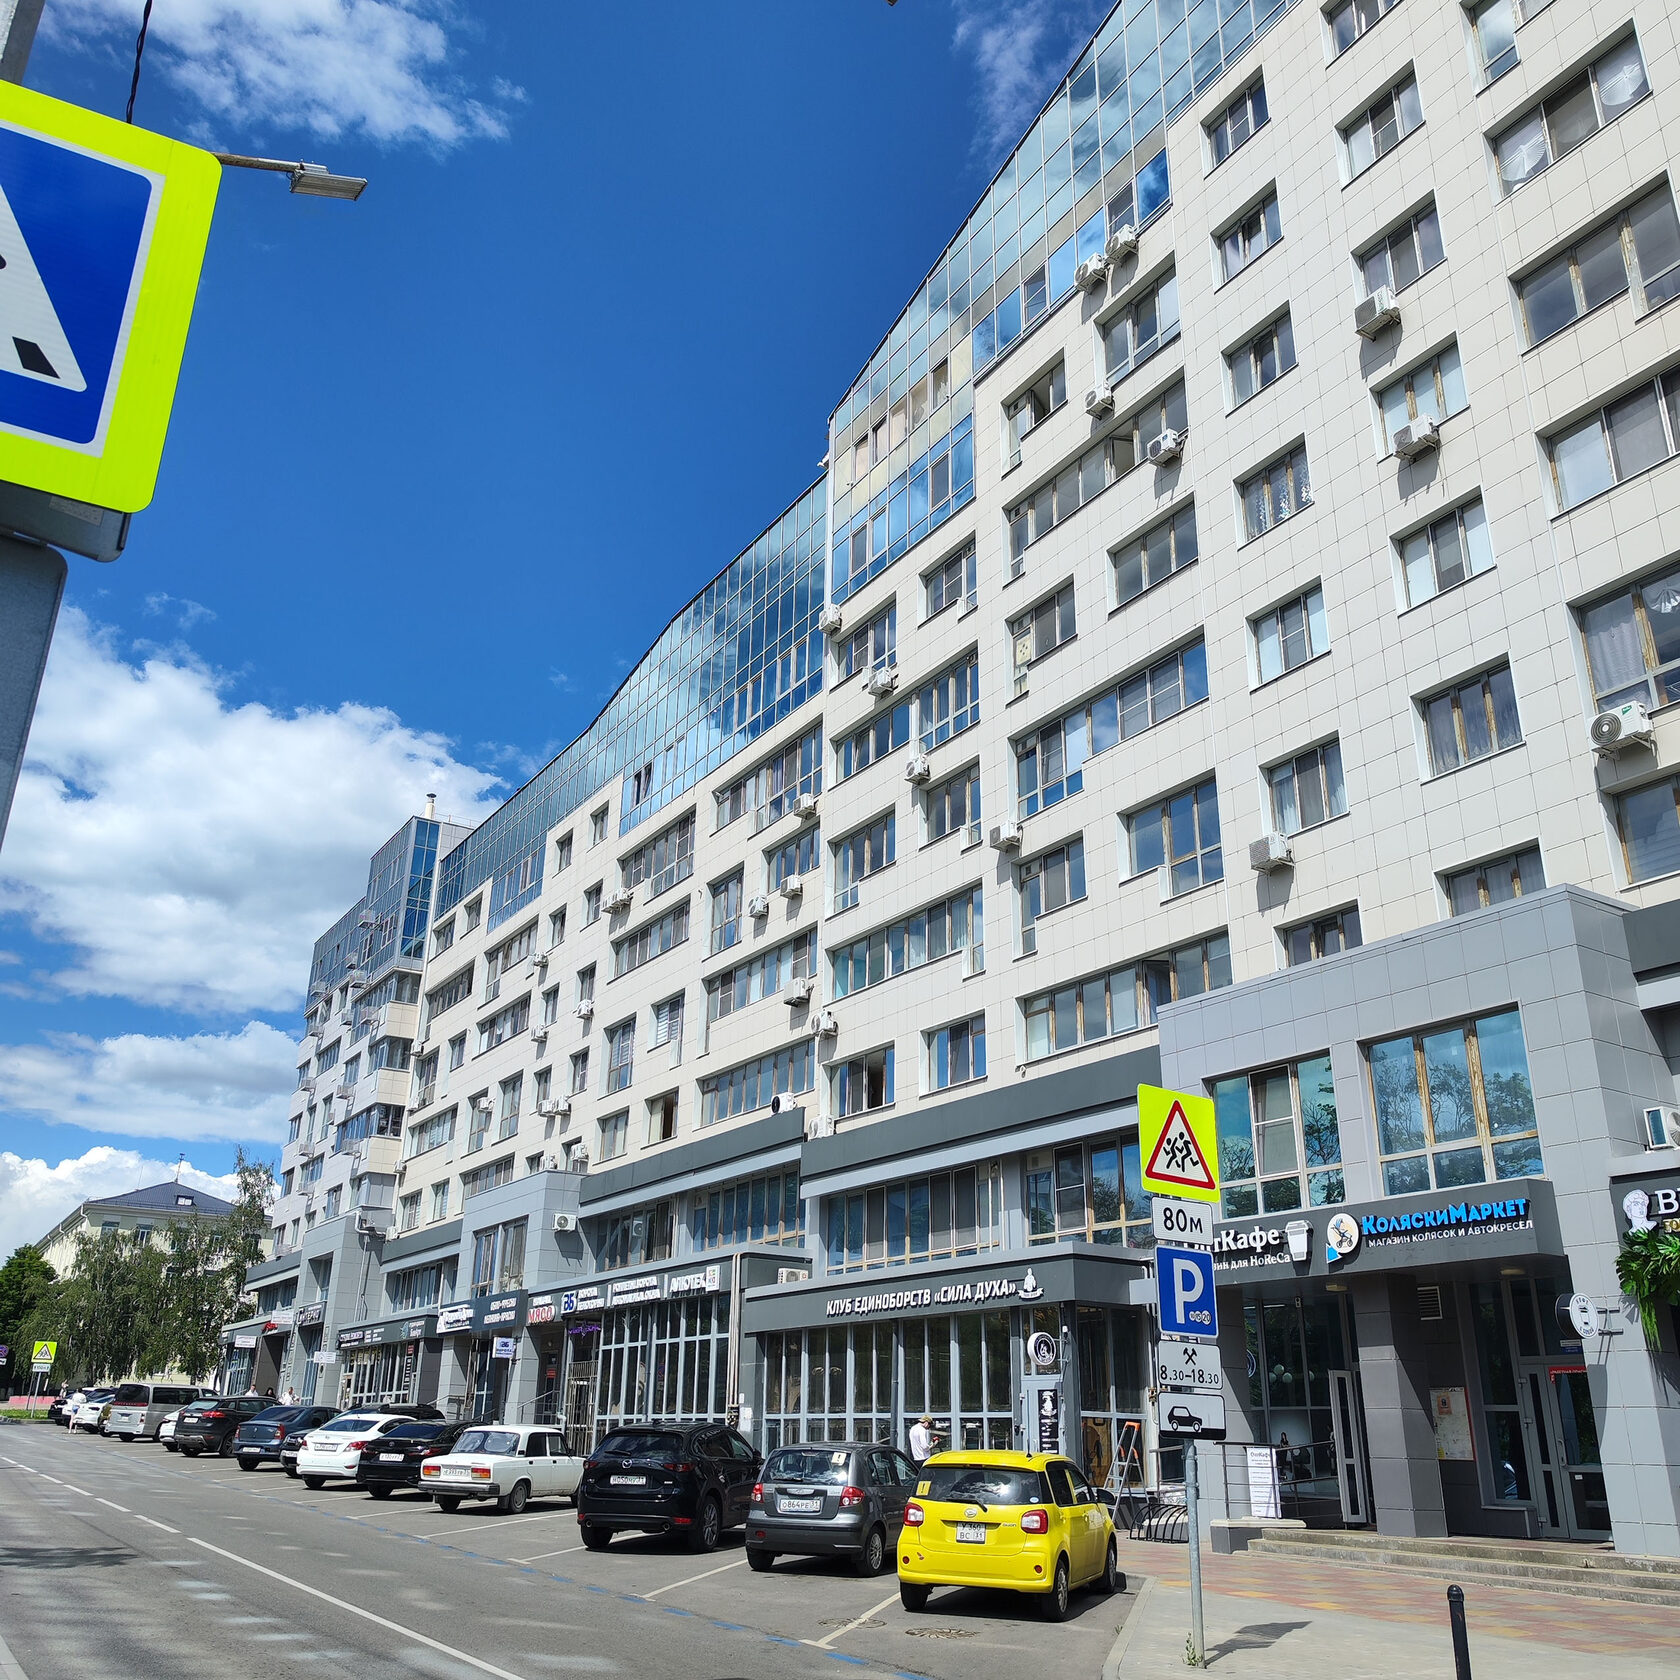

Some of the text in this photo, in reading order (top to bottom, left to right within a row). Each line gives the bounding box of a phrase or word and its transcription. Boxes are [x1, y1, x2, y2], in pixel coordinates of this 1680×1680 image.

[1368, 1219, 1534, 1248] МАГАЗИН КОЛЯСОК И АВТОКРЕСЕЛ
[1230, 1258, 1249, 1272] для
[1250, 1252, 1291, 1268] HoReCa
[826, 1279, 1017, 1316] КЛУБ ЕДИНОБОРСТВ «СИЛА ДУХА»
[528, 1306, 553, 1324] МЯСО
